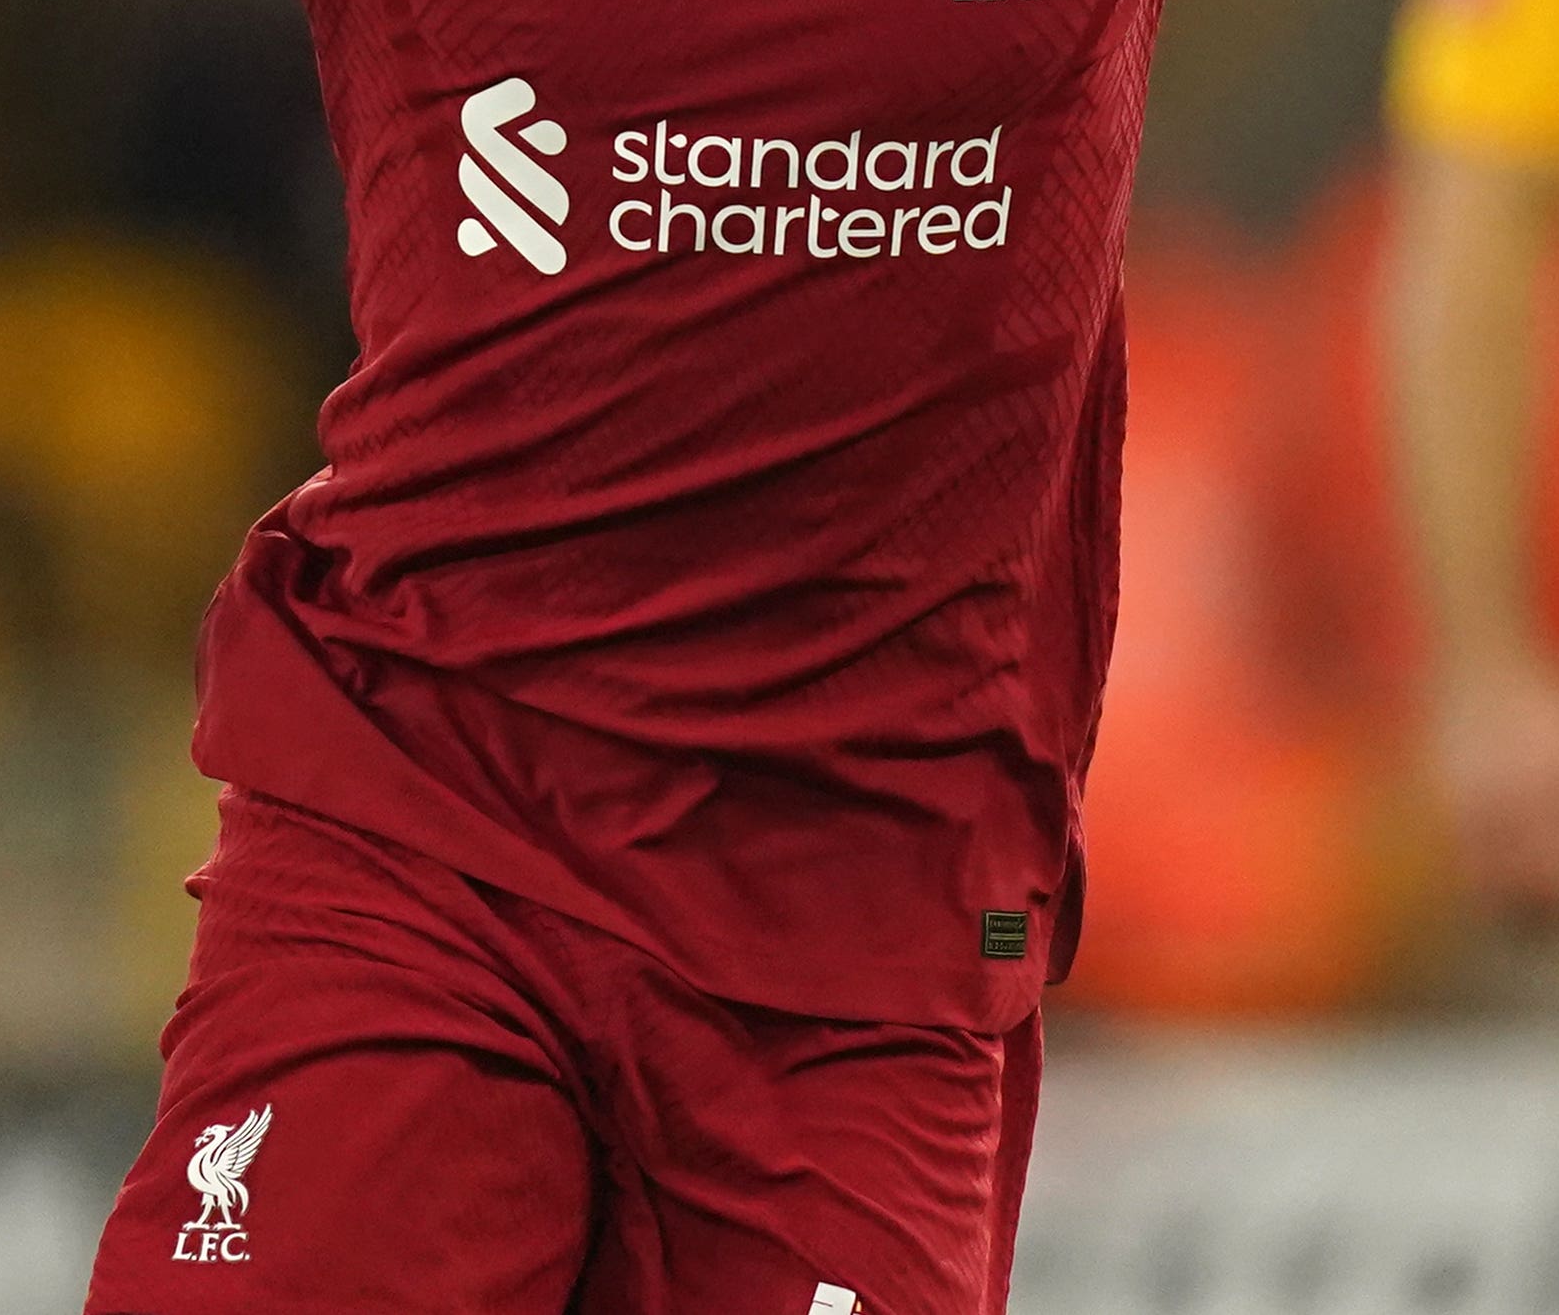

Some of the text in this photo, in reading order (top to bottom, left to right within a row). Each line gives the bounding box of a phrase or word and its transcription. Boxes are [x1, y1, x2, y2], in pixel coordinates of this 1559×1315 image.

[611, 118, 1004, 192] standard
[608, 185, 1013, 260] chartered
[171, 1231, 251, 1263] L.F.C.
